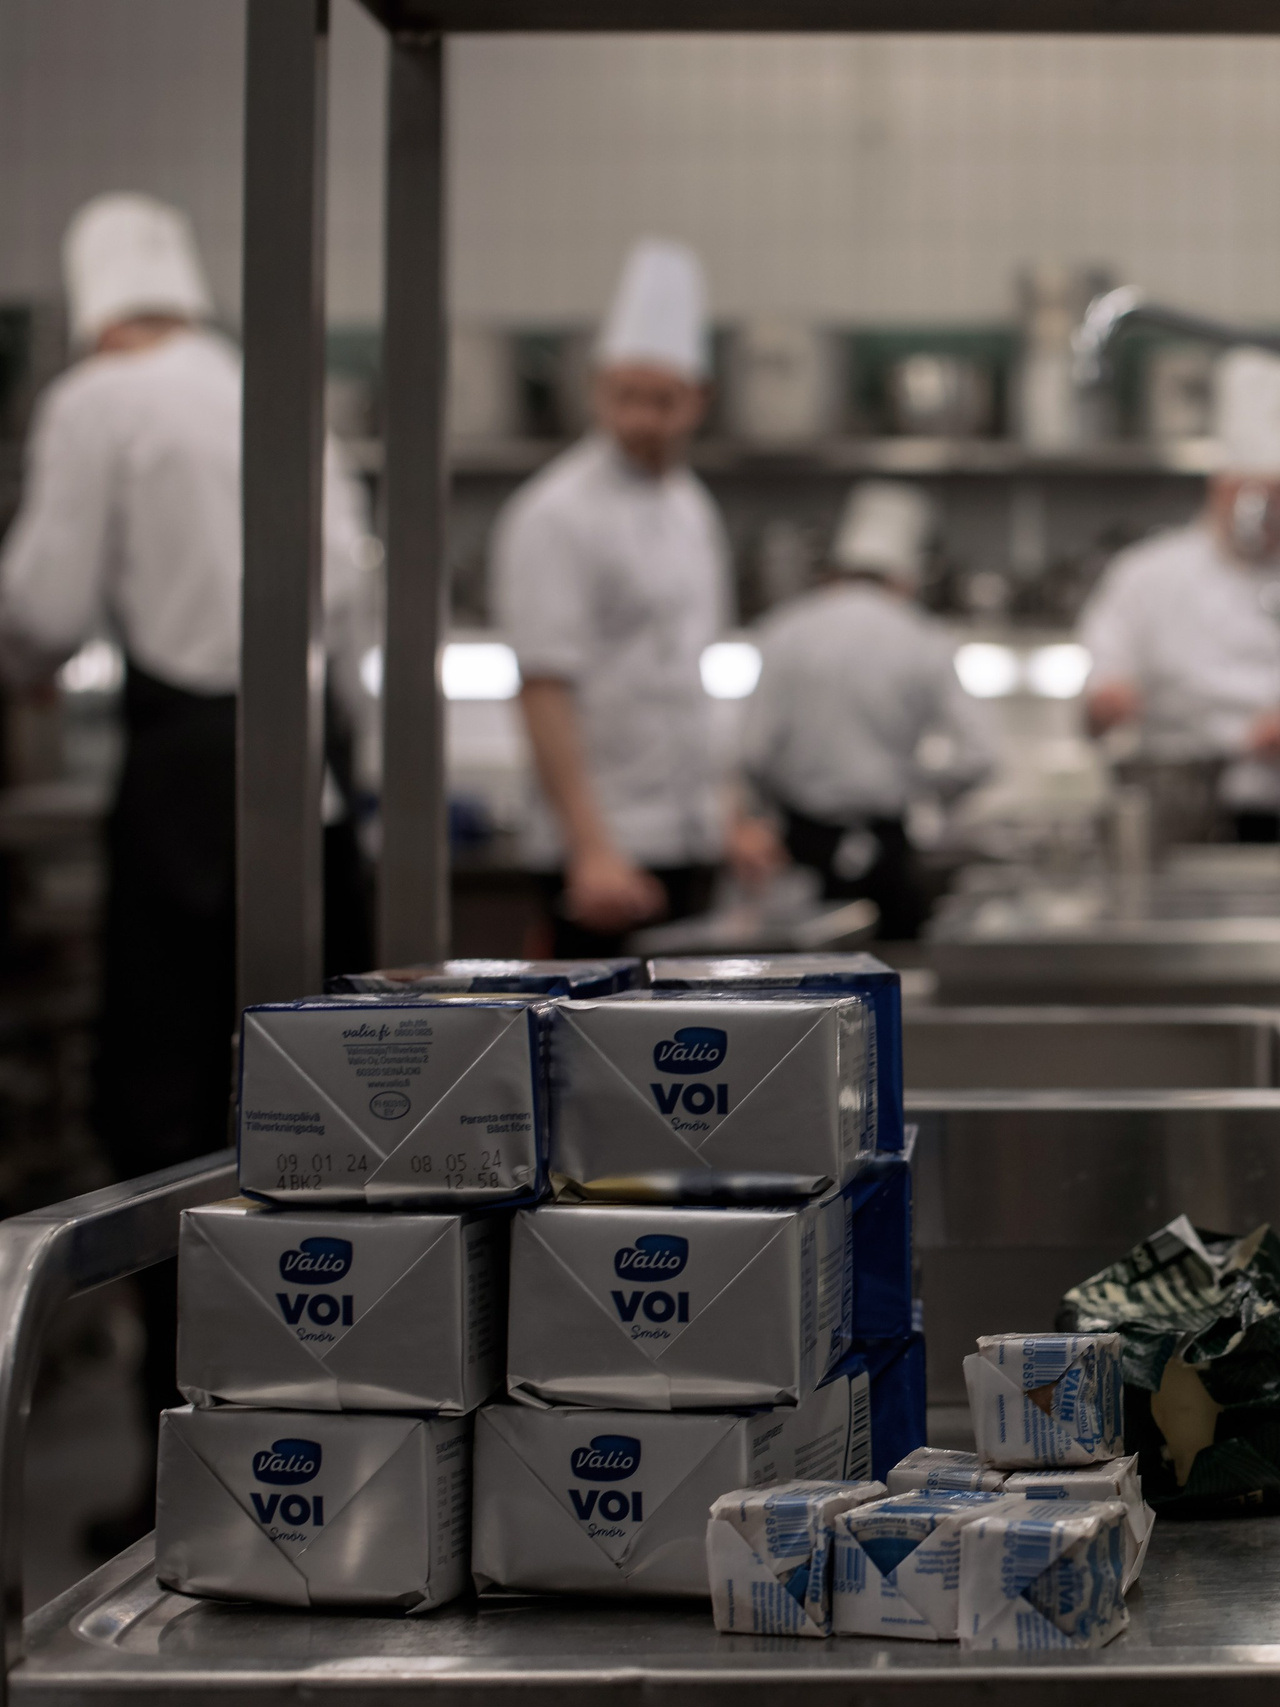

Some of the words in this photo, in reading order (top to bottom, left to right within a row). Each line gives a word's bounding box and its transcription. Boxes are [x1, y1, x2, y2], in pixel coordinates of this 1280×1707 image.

[341, 1023, 391, 1040] valio.fi
[658, 1041, 720, 1062] Valio
[649, 1083, 729, 1115] VOI
[245, 1110, 321, 1124] Valmistuspäivä
[459, 1114, 497, 1126] Parasta
[498, 1111, 531, 1122] ennen
[671, 1117, 711, 1132] Smör
[246, 1122, 326, 1136] Tillverkningsdag
[276, 1174, 323, 1191] 4BK2
[283, 1252, 345, 1272] Valio
[619, 1250, 681, 1270] Valio
[275, 1292, 354, 1326] VOI
[611, 1290, 690, 1323] VOI
[296, 1327, 336, 1342] Smör
[631, 1325, 671, 1340] Smör
[1060, 1368, 1082, 1422] HIIVA
[257, 1453, 316, 1474] Valio
[575, 1448, 635, 1470] Valio
[249, 1493, 325, 1526] VOI
[567, 1489, 643, 1522] VOI
[269, 1528, 308, 1543] Smör
[587, 1524, 626, 1540] Smör
